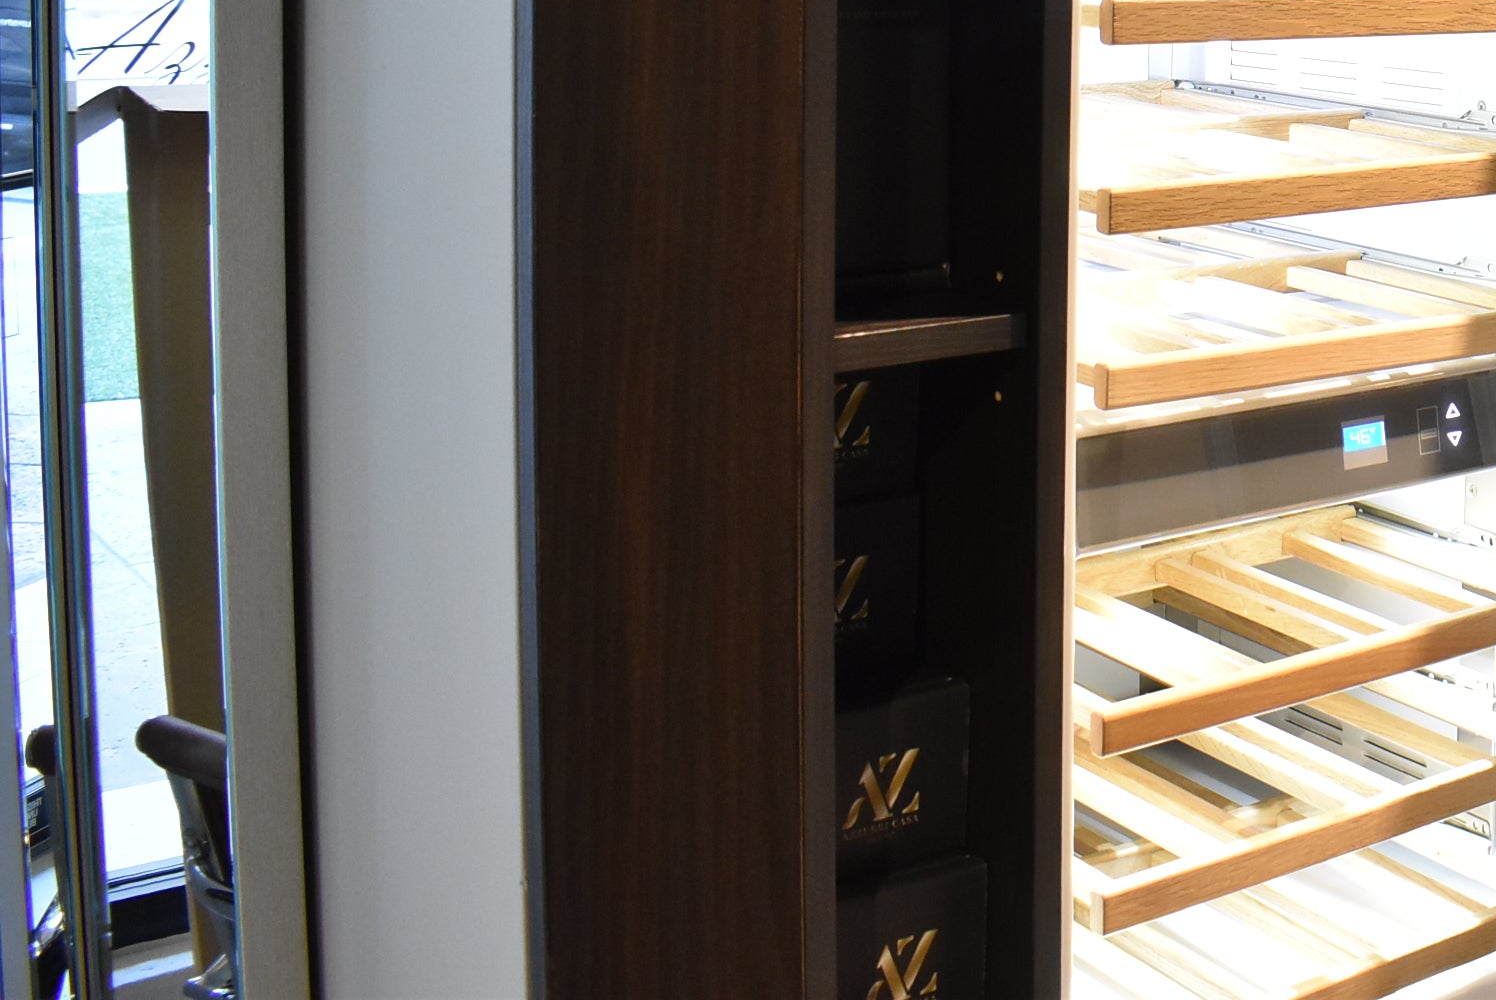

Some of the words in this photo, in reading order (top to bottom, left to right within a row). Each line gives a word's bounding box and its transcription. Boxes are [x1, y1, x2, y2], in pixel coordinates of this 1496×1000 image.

[834, 381, 871, 448] Z
[841, 746, 921, 830] AZ
[866, 928, 940, 1000] AZ
